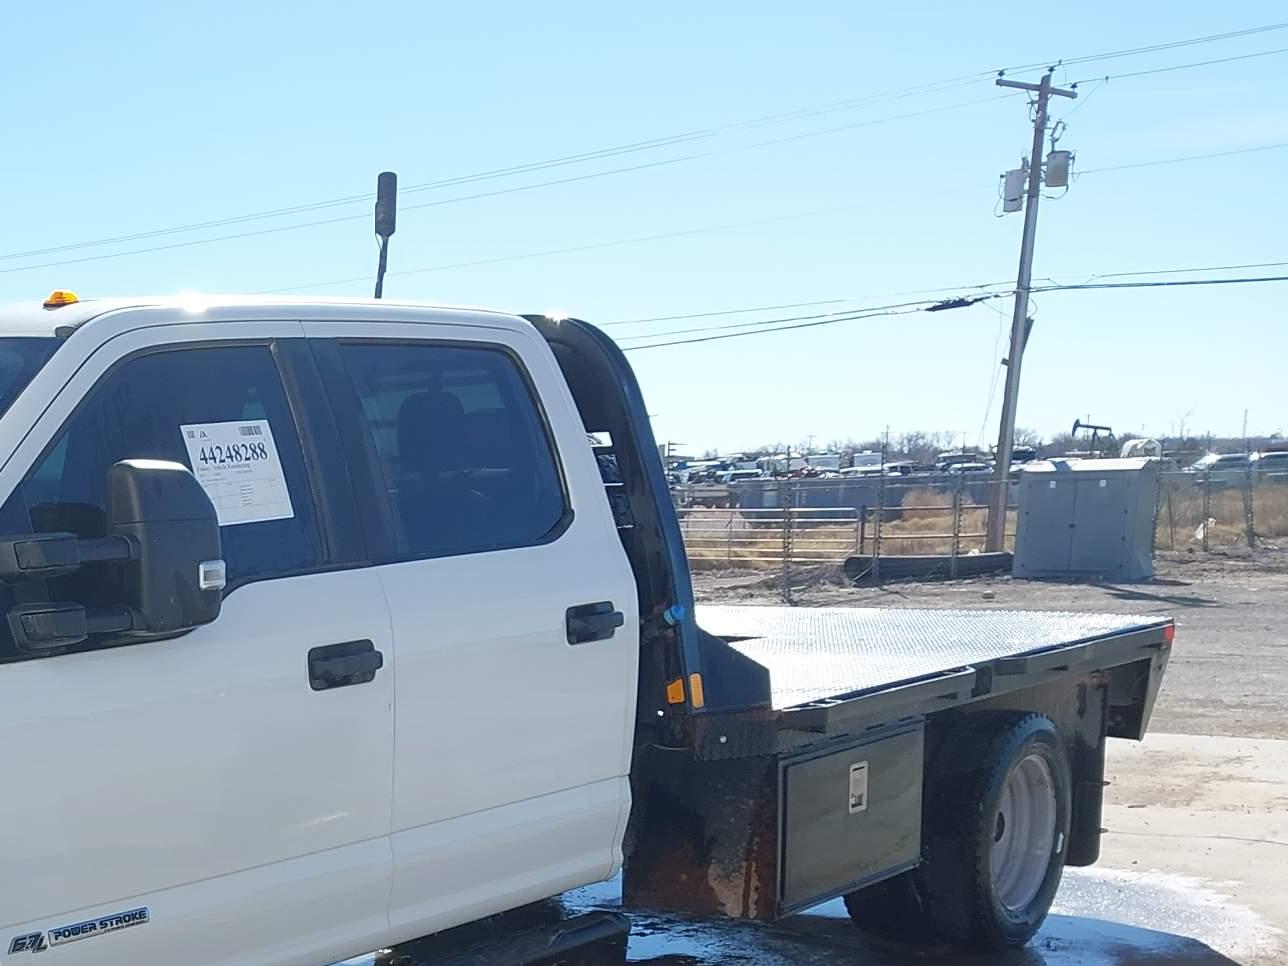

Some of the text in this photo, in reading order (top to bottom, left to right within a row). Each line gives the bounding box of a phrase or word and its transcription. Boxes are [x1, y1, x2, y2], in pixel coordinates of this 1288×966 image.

[199, 442, 268, 465] 44248288
[53, 922, 98, 941] POWER
[99, 910, 147, 929] STROKE
